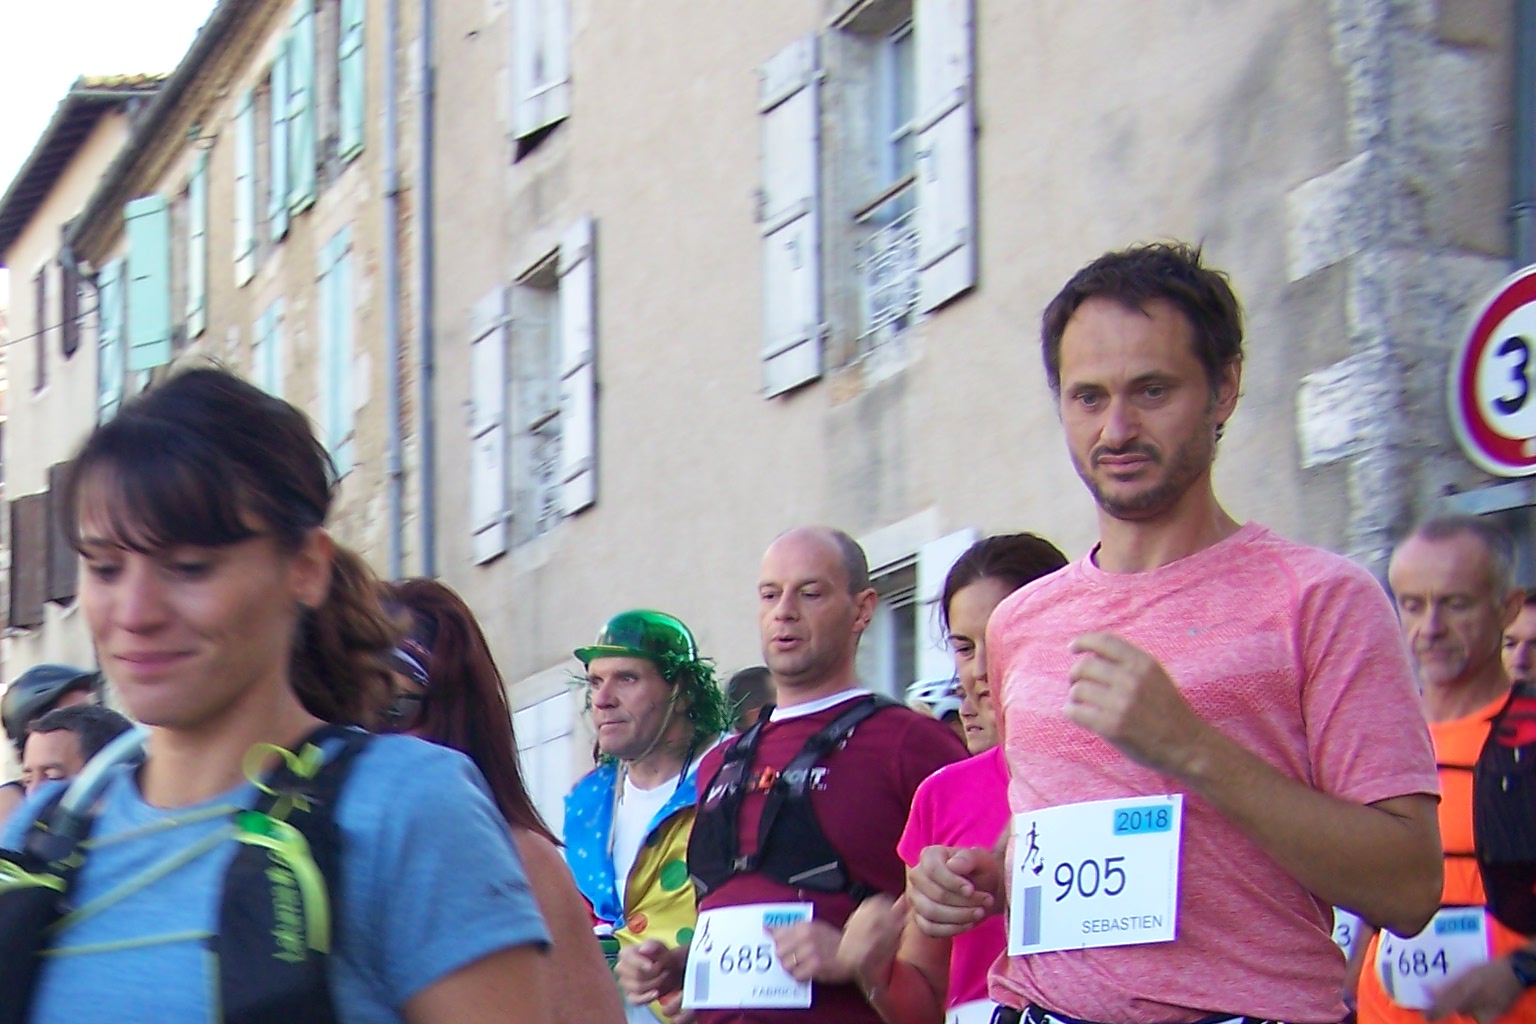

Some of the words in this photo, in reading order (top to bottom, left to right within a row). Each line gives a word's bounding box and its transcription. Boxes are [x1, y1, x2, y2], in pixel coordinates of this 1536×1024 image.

[1117, 809, 1168, 831] 2018
[1054, 856, 1126, 902] 905
[1081, 914, 1163, 934] SEBASTIEN
[720, 944, 772, 974] 685
[1398, 948, 1448, 977] 684
